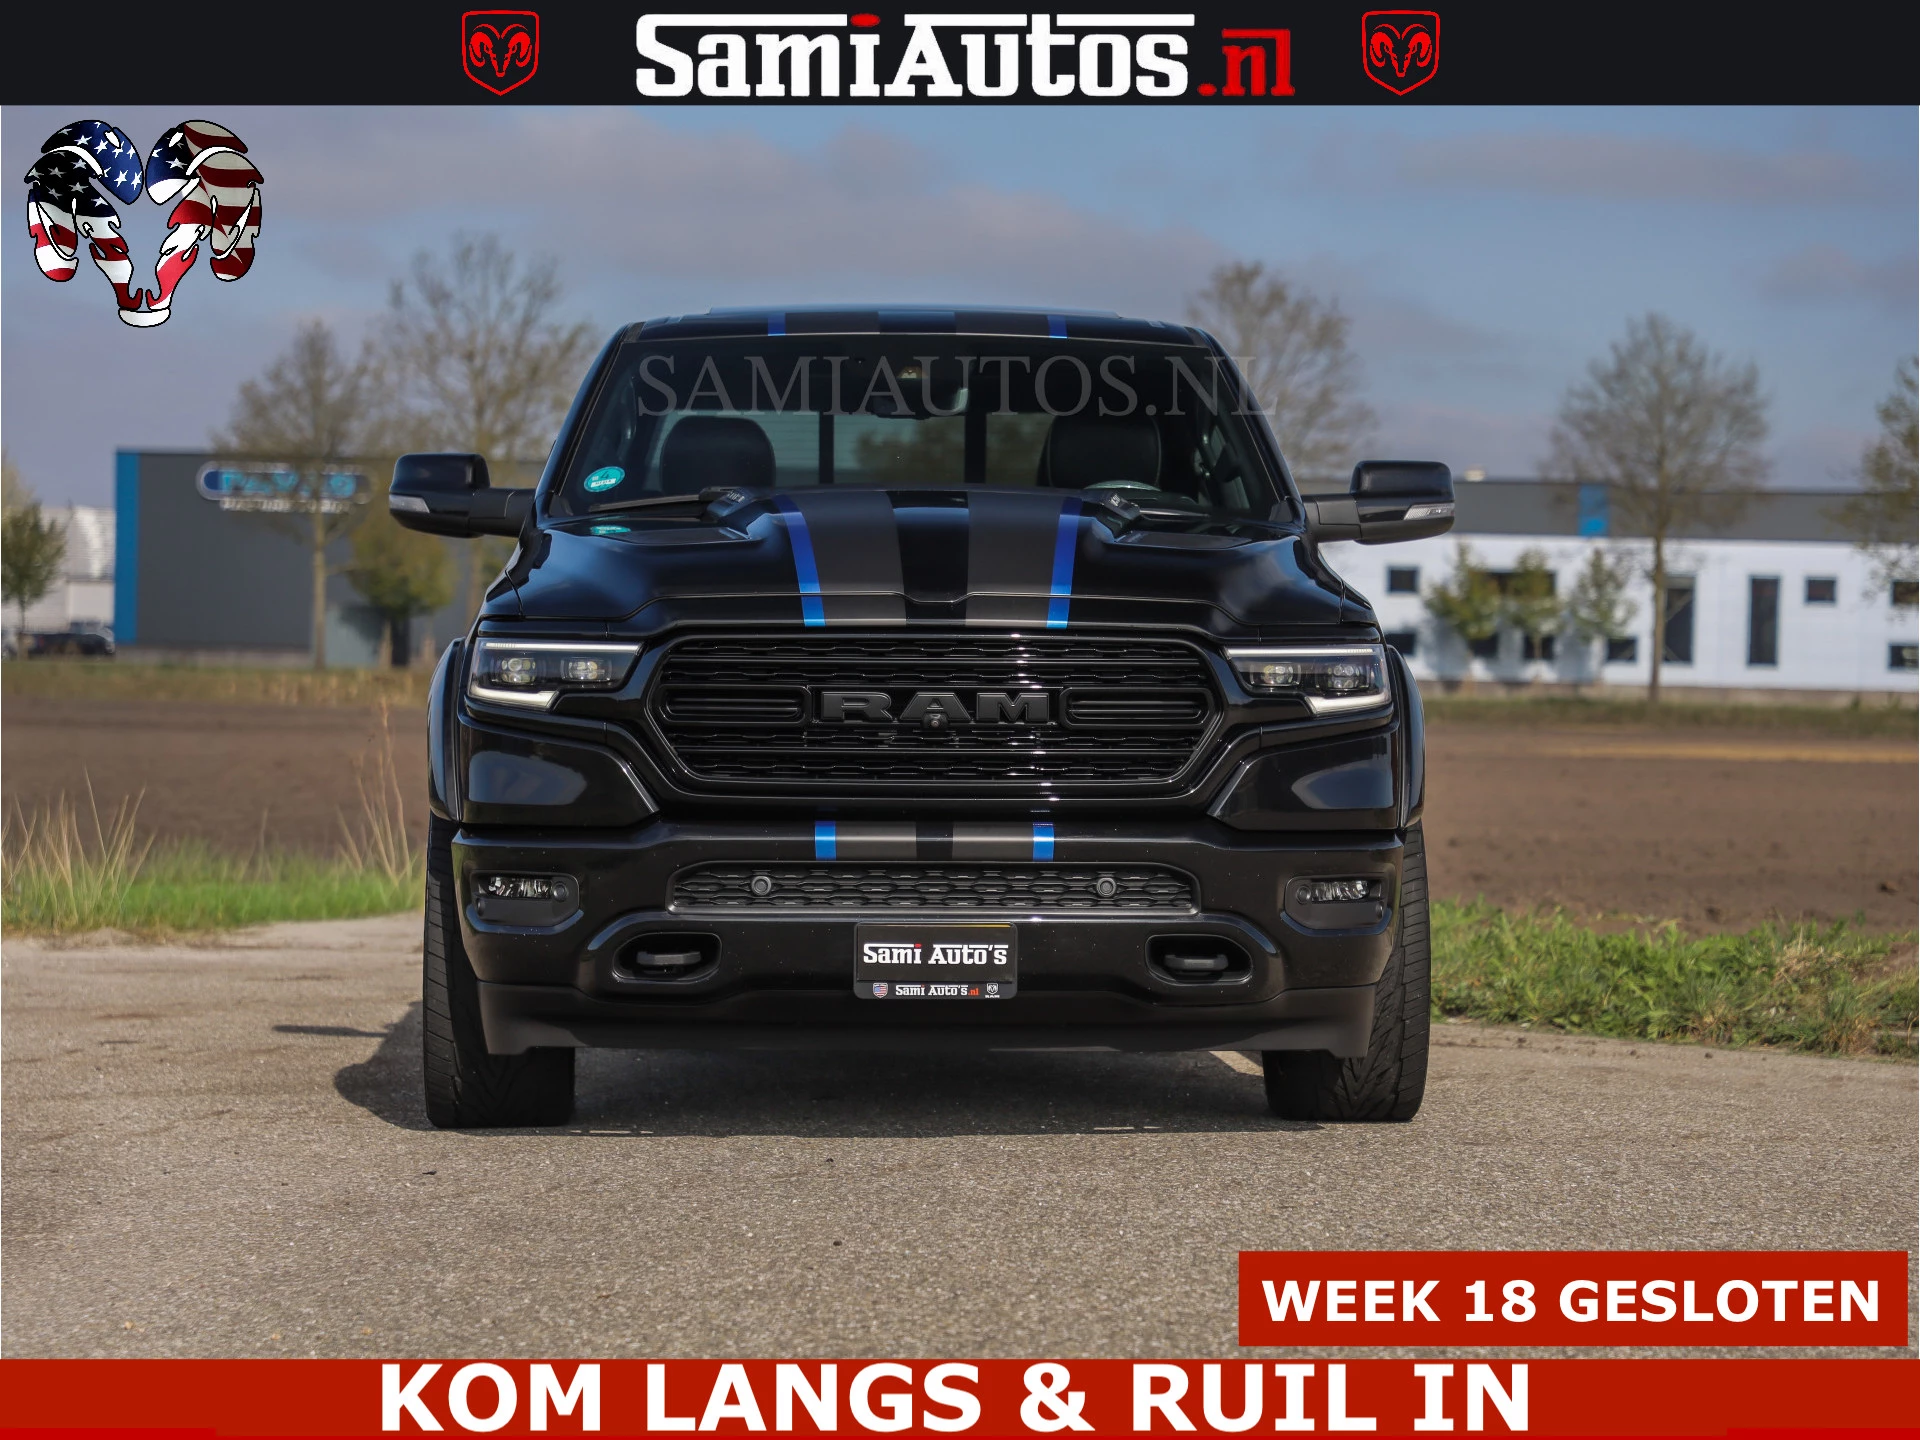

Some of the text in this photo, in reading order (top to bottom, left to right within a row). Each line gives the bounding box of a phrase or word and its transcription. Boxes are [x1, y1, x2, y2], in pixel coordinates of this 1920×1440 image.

[821, 691, 1050, 723] RAM
[863, 943, 1009, 965] Sami Auto's
[895, 984, 926, 996] Sami
